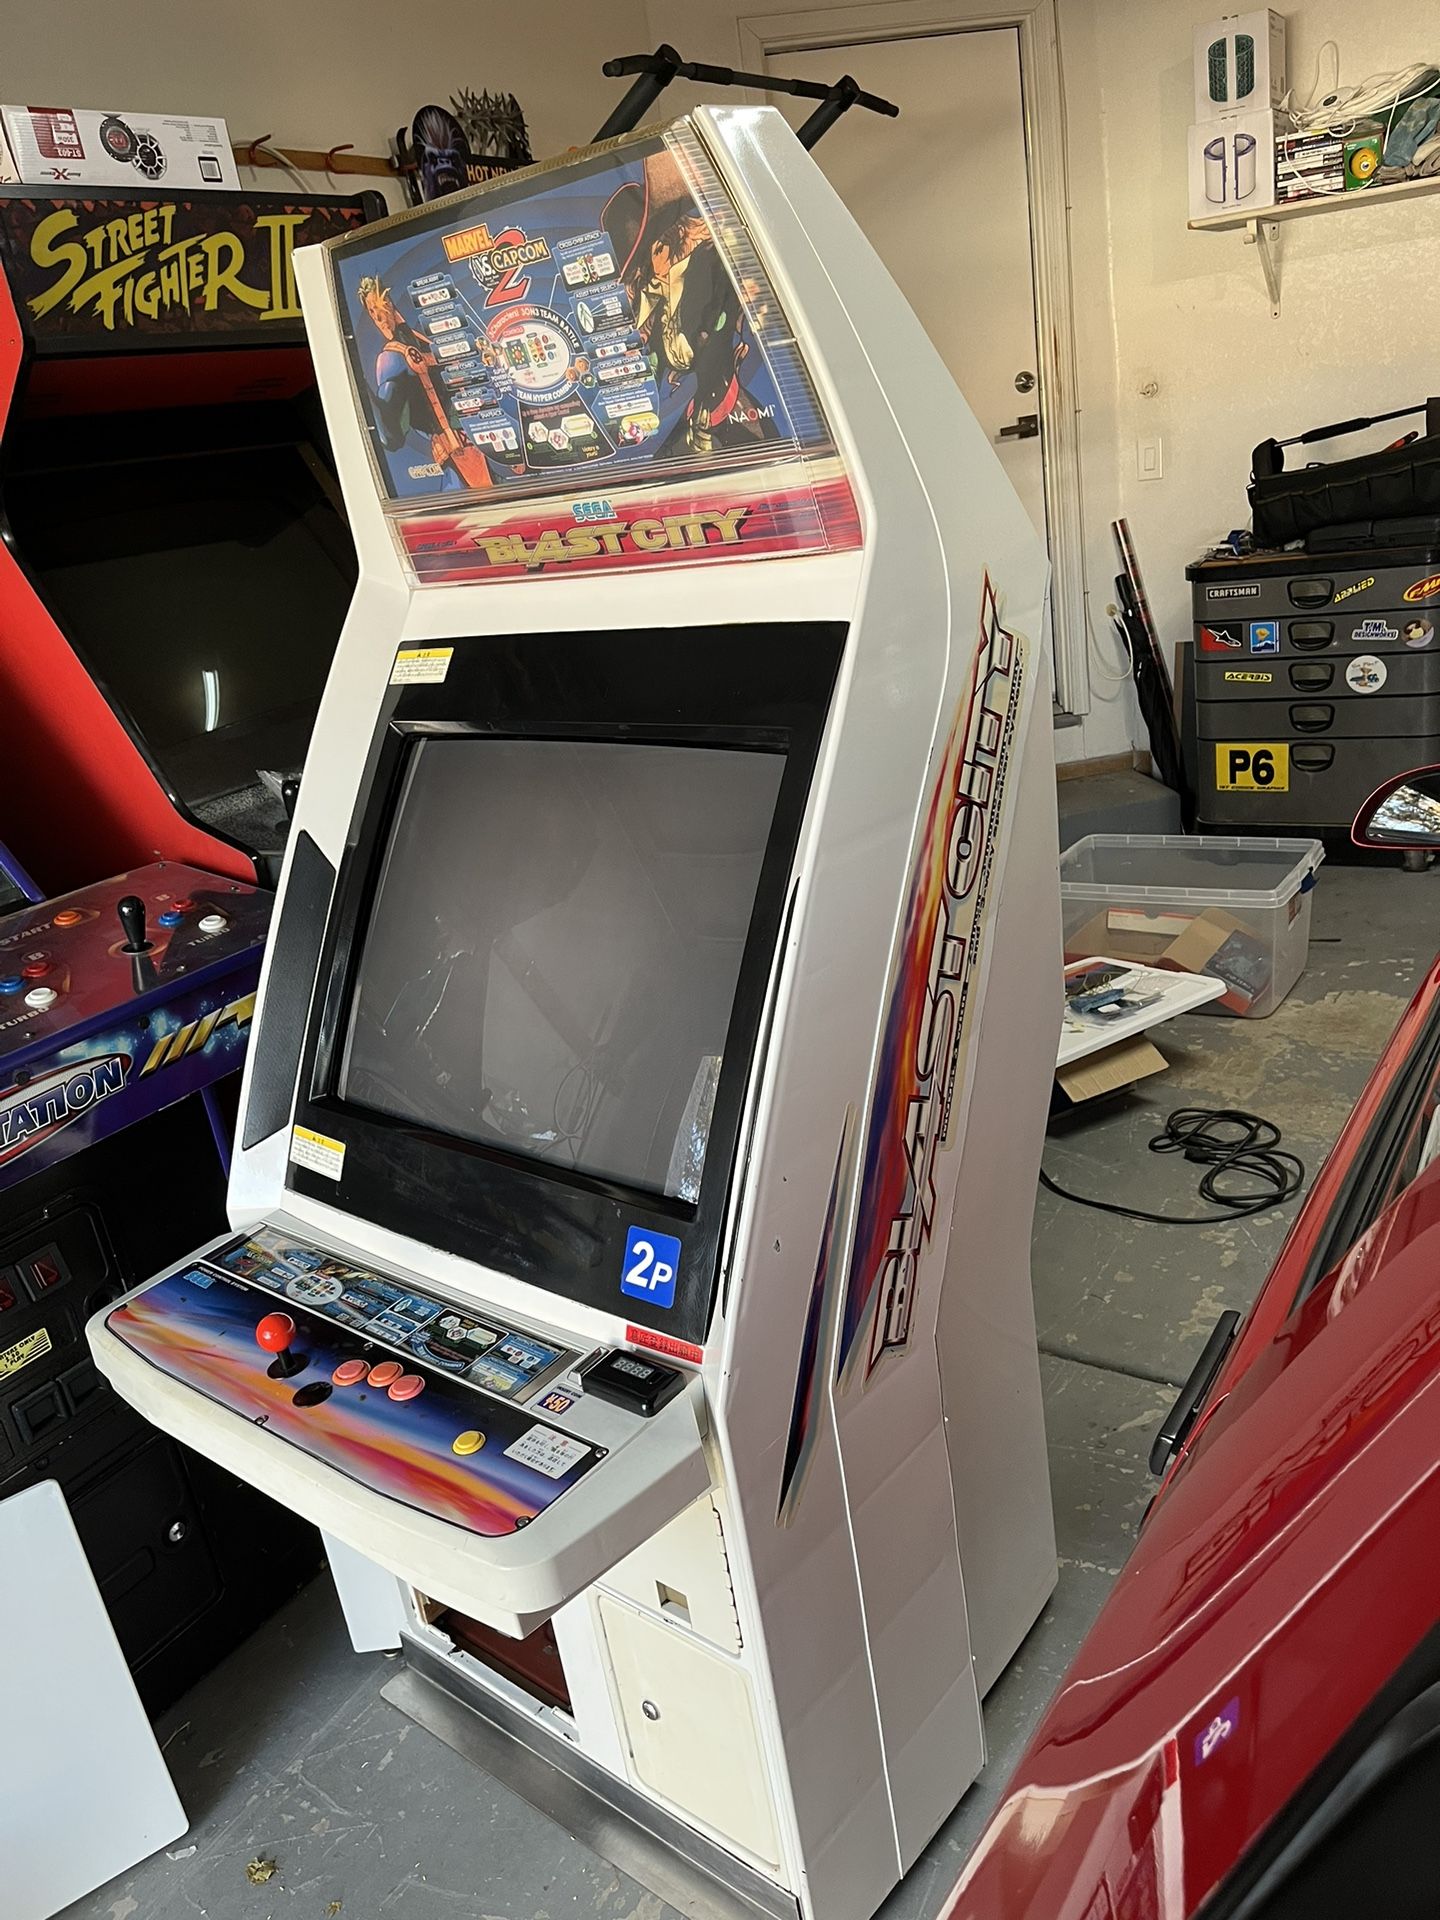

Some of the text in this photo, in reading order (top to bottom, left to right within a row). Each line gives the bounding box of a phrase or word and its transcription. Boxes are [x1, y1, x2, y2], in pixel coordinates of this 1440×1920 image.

[466, 164, 489, 182] HOT
[445, 227, 492, 259] MARVEL
[493, 241, 548, 270] CAPCOM
[26, 205, 177, 321] STREET
[484, 227, 531, 308] 2
[67, 231, 271, 331] FIGHTER
[540, 309, 560, 324] TEAM
[559, 320, 580, 348] BATTLE
[517, 389, 533, 402] TEAM
[532, 393, 554, 403] HYPER
[728, 404, 775, 425] NAOMI
[571, 500, 617, 523] SEGA
[474, 508, 752, 568] BLAST CITY
[1209, 587, 1258, 598] CRAFTSMAN
[1227, 673, 1271, 682] ACERBIS
[1229, 749, 1275, 785] P6
[0, 922, 51, 947] START
[187, 928, 231, 946] TURBO
[864, 572, 1014, 1384] BLAST CITY
[0, 1007, 49, 1030] TURBO
[625, 1240, 673, 1291] 2P
[19, 1335, 36, 1348] ONLY
[543, 1394, 571, 1412] ¥50
